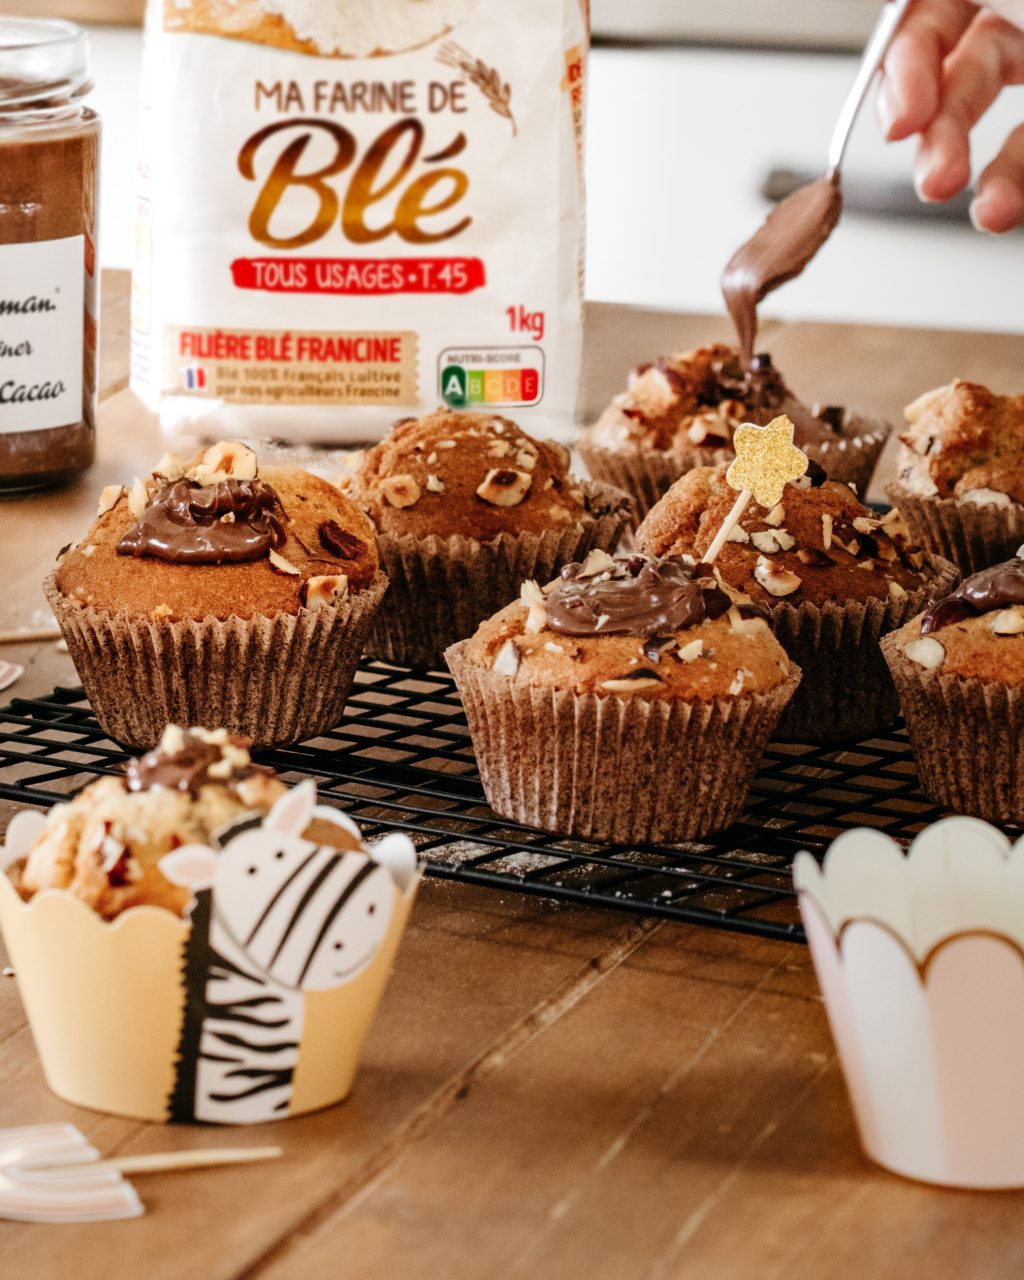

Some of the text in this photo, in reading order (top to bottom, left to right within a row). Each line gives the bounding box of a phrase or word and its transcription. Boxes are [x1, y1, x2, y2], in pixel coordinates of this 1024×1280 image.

[255, 81, 468, 113] MA FARINE DE
[237, 117, 473, 249] Blé
[252, 262, 468, 289] TOUS USAGES T.45
[506, 304, 545, 341] 1kg
[179, 330, 401, 363] FILIÈRE BLÉ FRANCINE
[447, 353, 521, 364] NUTRI-SCORE
[283, 367, 345, 385] français
[348, 369, 401, 382] cultivé
[266, 384, 343, 400] agriculteurs
[345, 384, 401, 397] Francine
